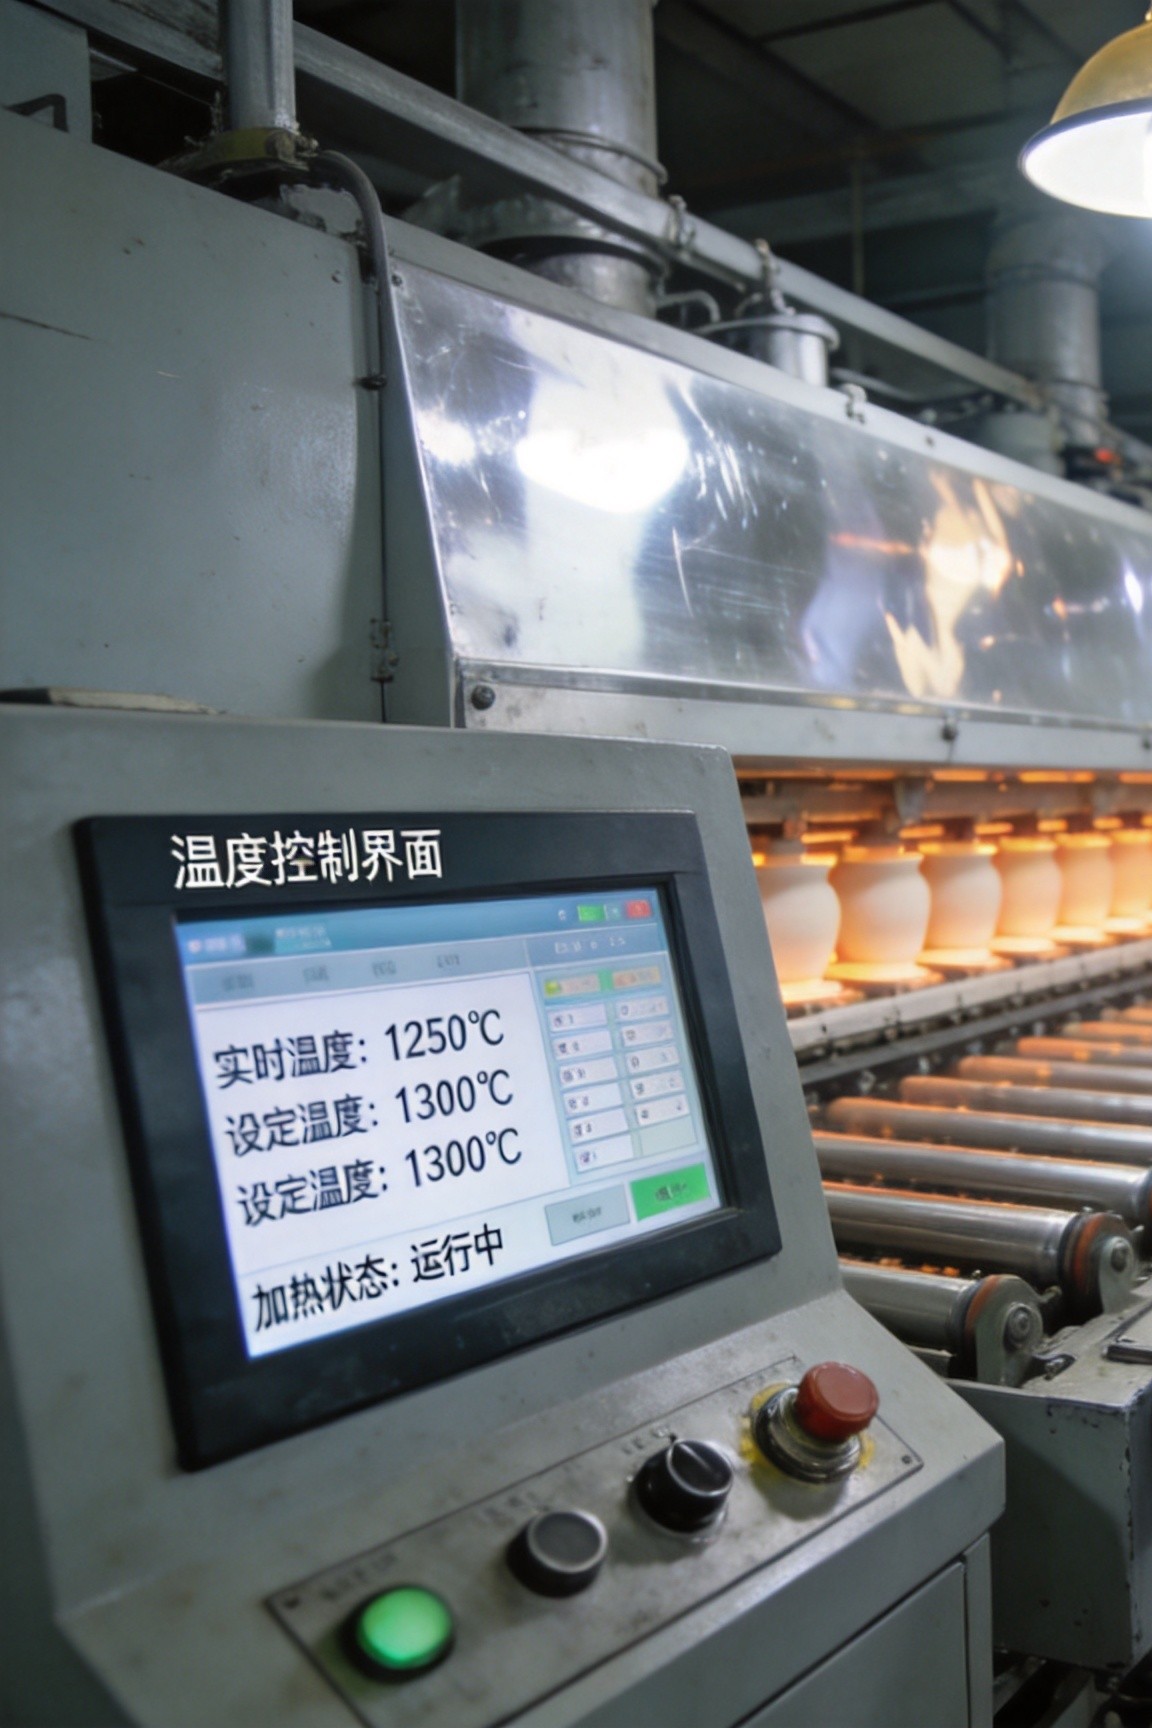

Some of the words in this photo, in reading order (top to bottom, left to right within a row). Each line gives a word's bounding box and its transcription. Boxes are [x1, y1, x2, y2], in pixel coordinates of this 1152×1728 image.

[171, 828, 443, 889] 温度控制界面
[385, 1009, 504, 1061] 1250℃
[395, 1069, 514, 1124] 1300℃
[405, 1127, 522, 1187] 1300℃
[411, 1223, 503, 1283] 运行中
